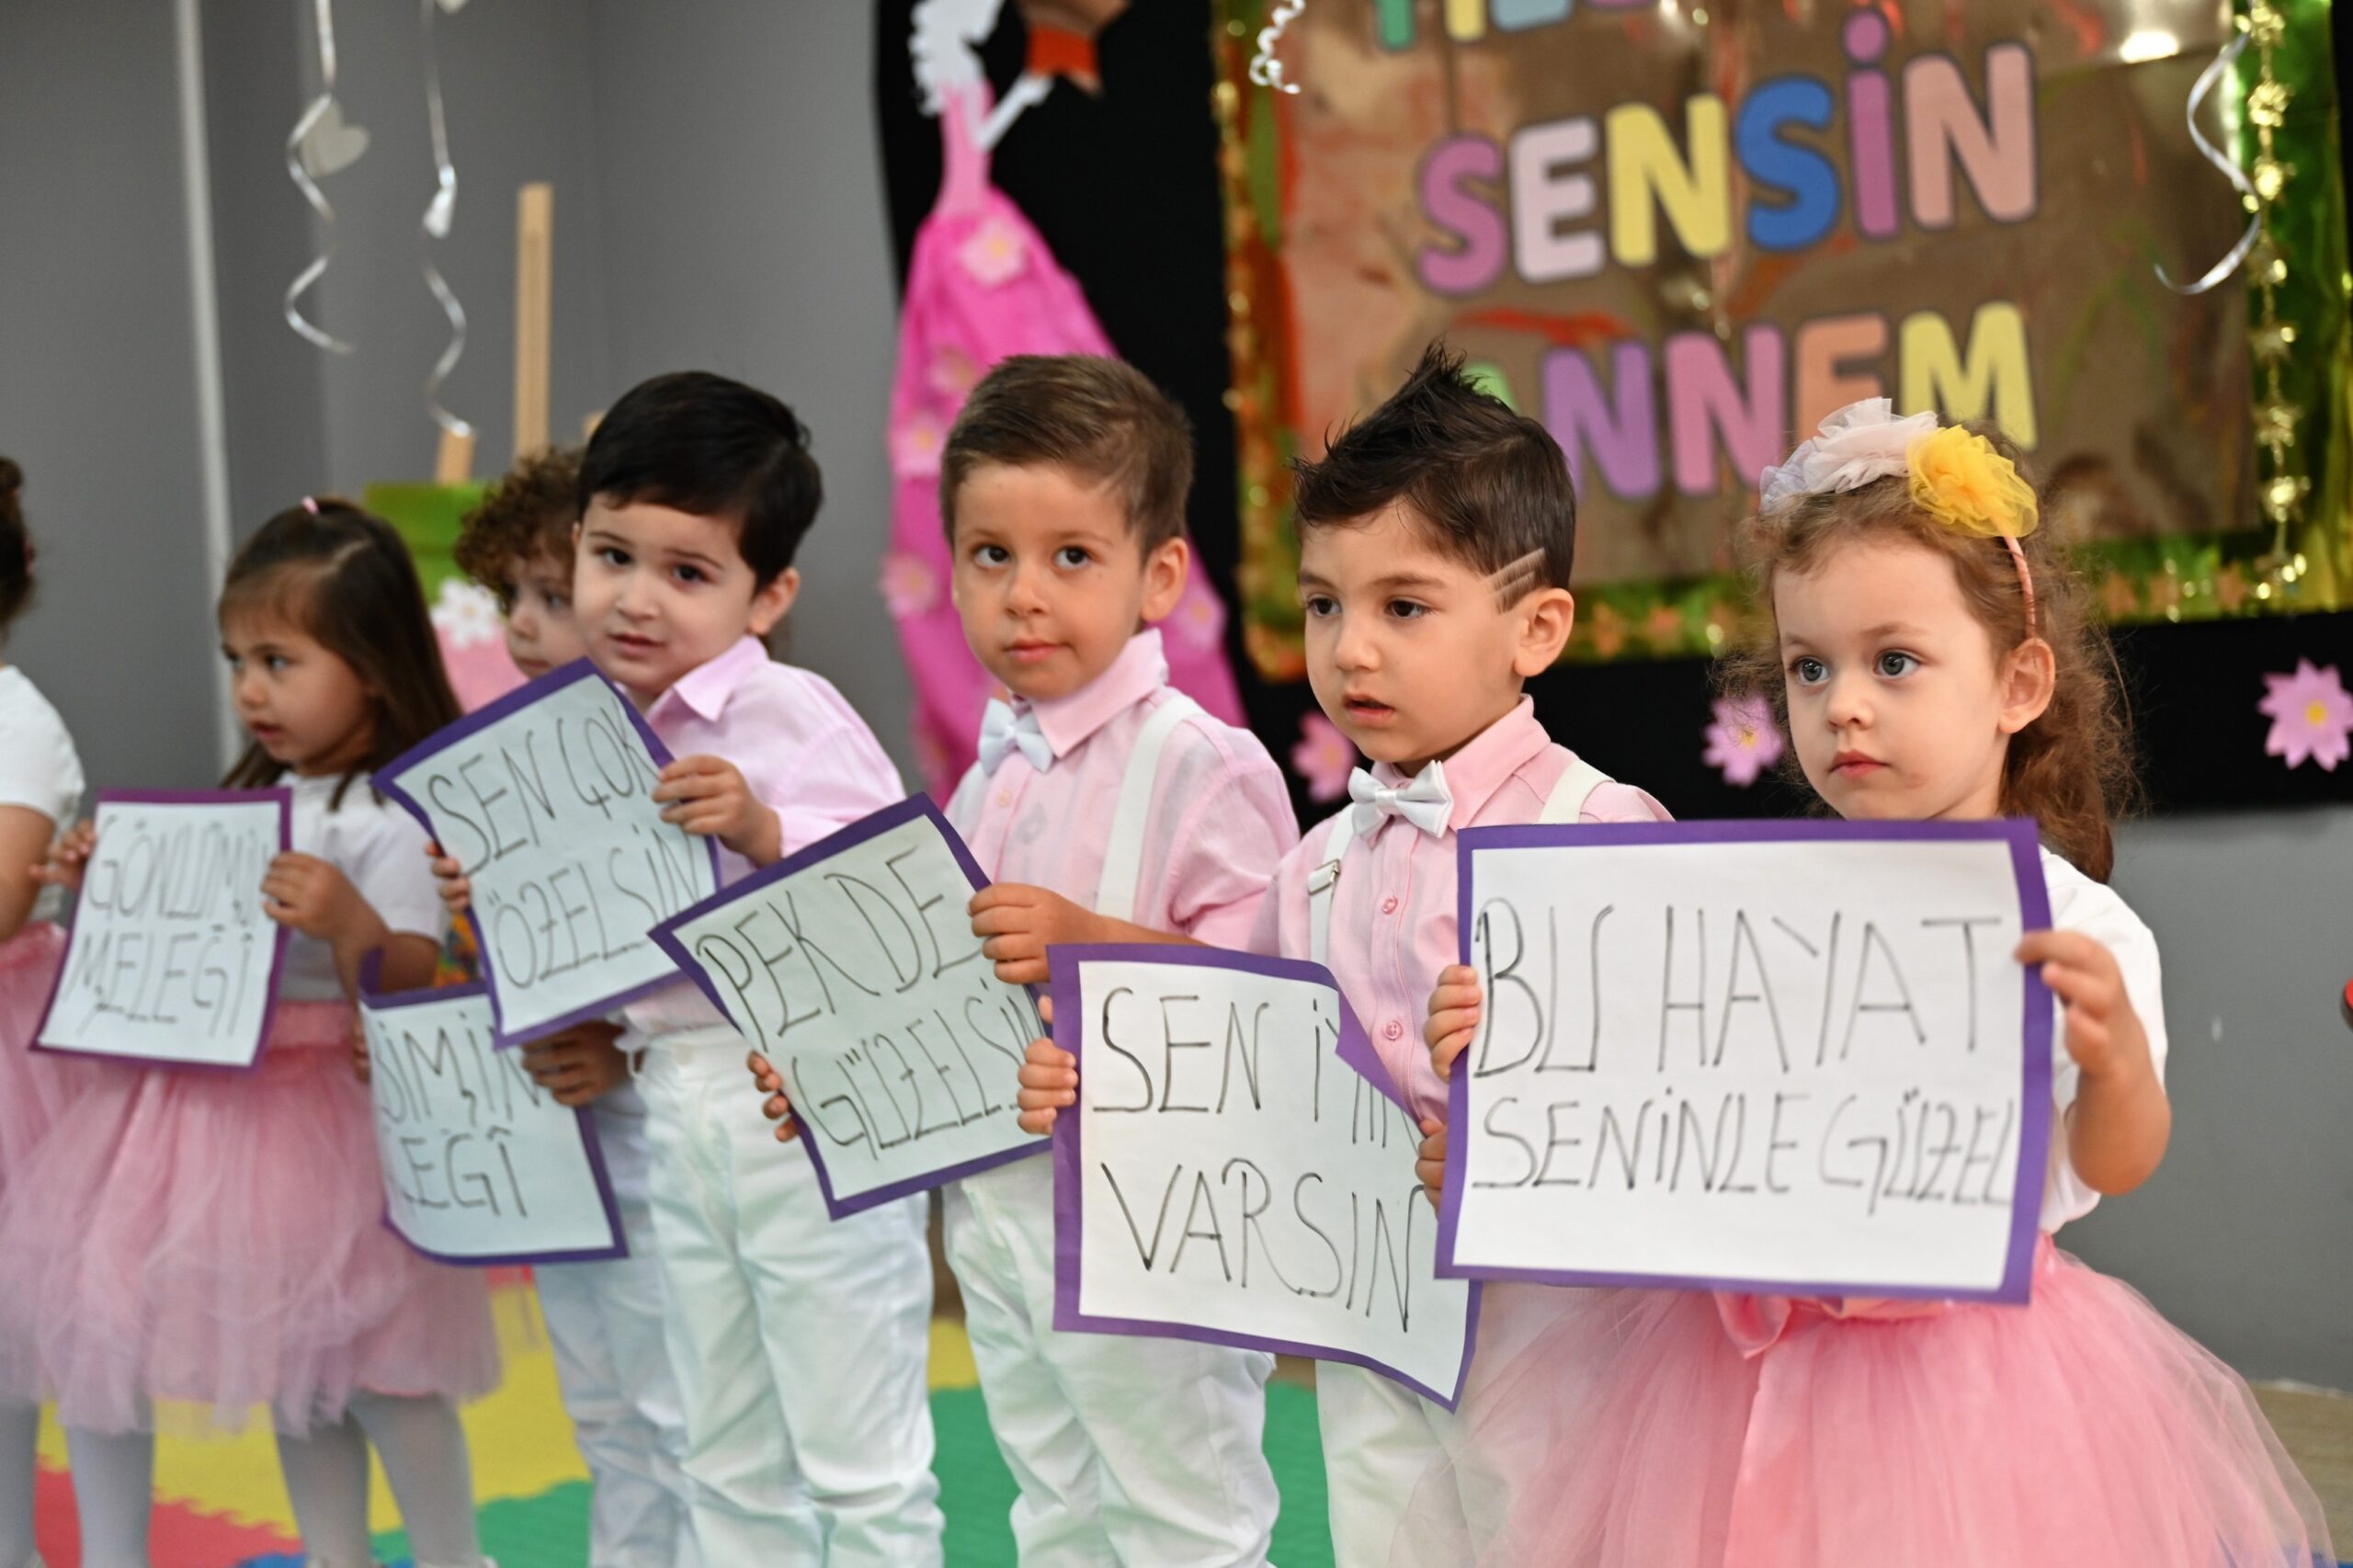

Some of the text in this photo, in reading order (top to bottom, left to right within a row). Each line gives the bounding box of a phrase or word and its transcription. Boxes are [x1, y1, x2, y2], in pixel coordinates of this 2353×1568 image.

[1418, 11, 2037, 294] SENSİN
[1466, 301, 2037, 500] NNEM
[427, 697, 659, 877] SEN ÇOK
[696, 846, 984, 1053] PEK DE
[1658, 904, 2002, 1074] HAYAT
[1092, 986, 1270, 1115] SEN
[1472, 1085, 2013, 1216] SENİNLE GÜZEL
[1100, 1158, 1426, 1333] VARSIN
